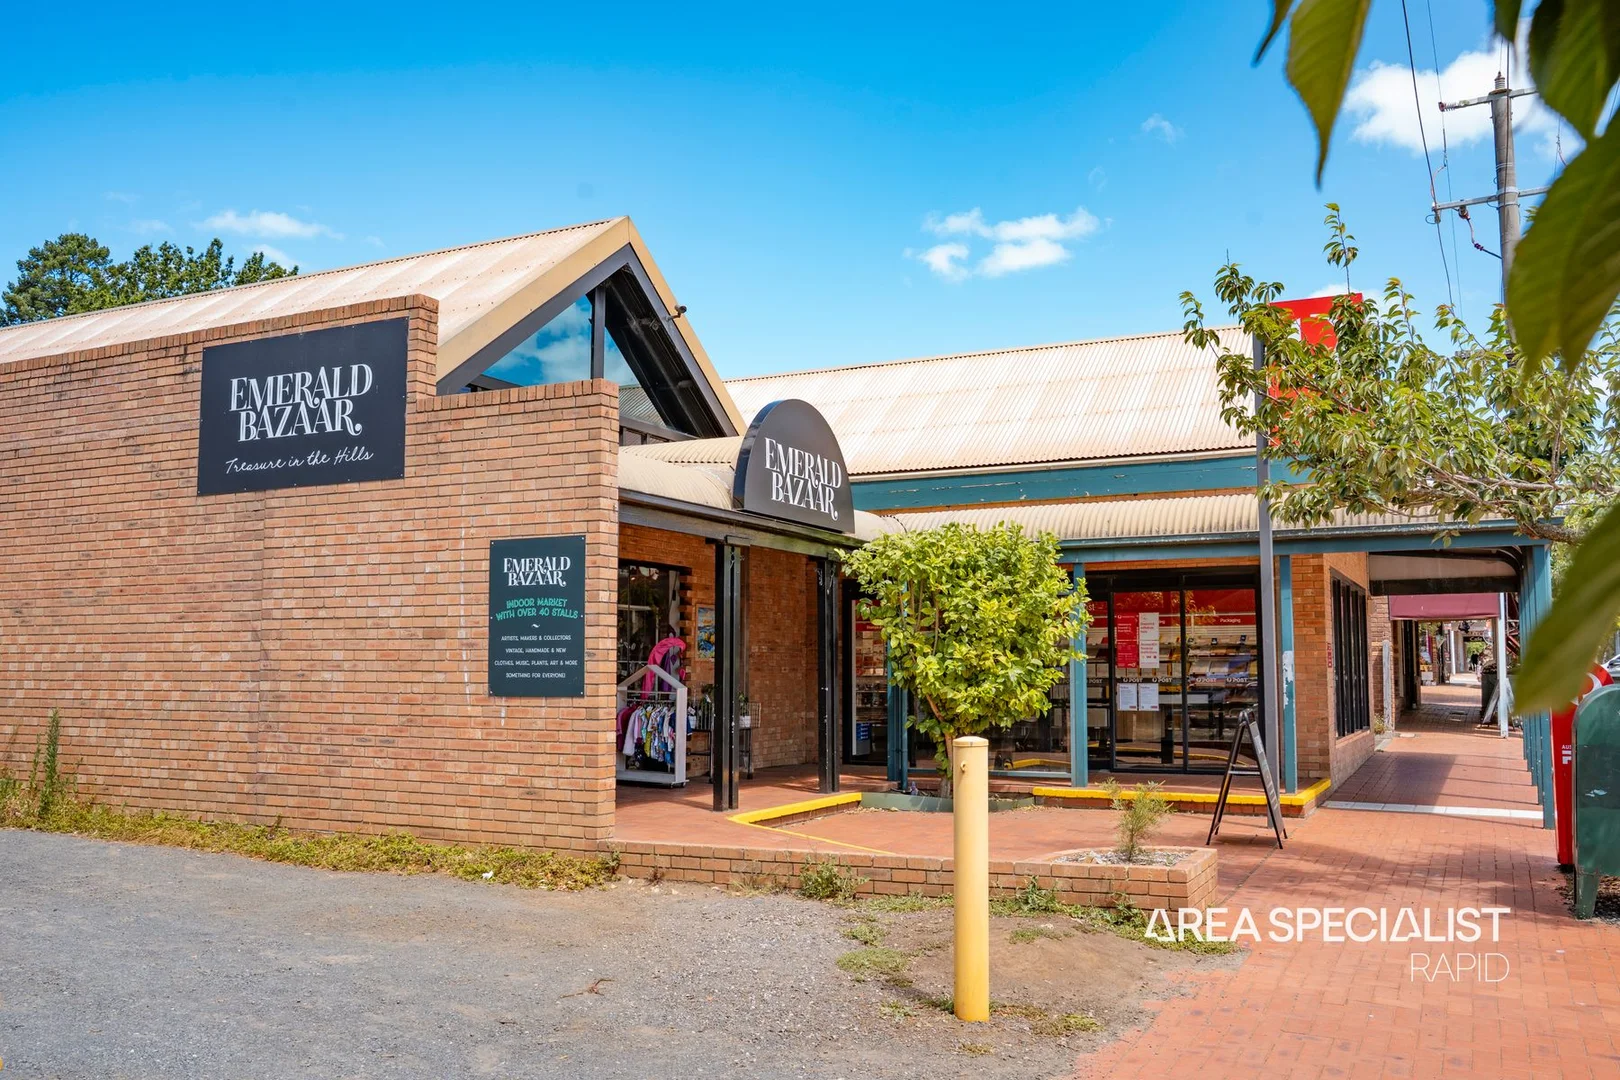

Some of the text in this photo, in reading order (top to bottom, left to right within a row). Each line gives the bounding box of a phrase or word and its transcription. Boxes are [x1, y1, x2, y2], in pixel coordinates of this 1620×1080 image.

[229, 363, 373, 413] EMERALD
[238, 398, 363, 442] BAZAAR
[226, 446, 374, 475] Treasure in the Hills
[764, 437, 842, 489] EMERALD
[771, 471, 839, 521] BAZAAR
[503, 556, 571, 575] EMERALD
[508, 570, 567, 588] BAZAAR
[495, 607, 579, 621] WITH OVER 40 STALLS
[506, 597, 568, 609] INDOOR MARKET
